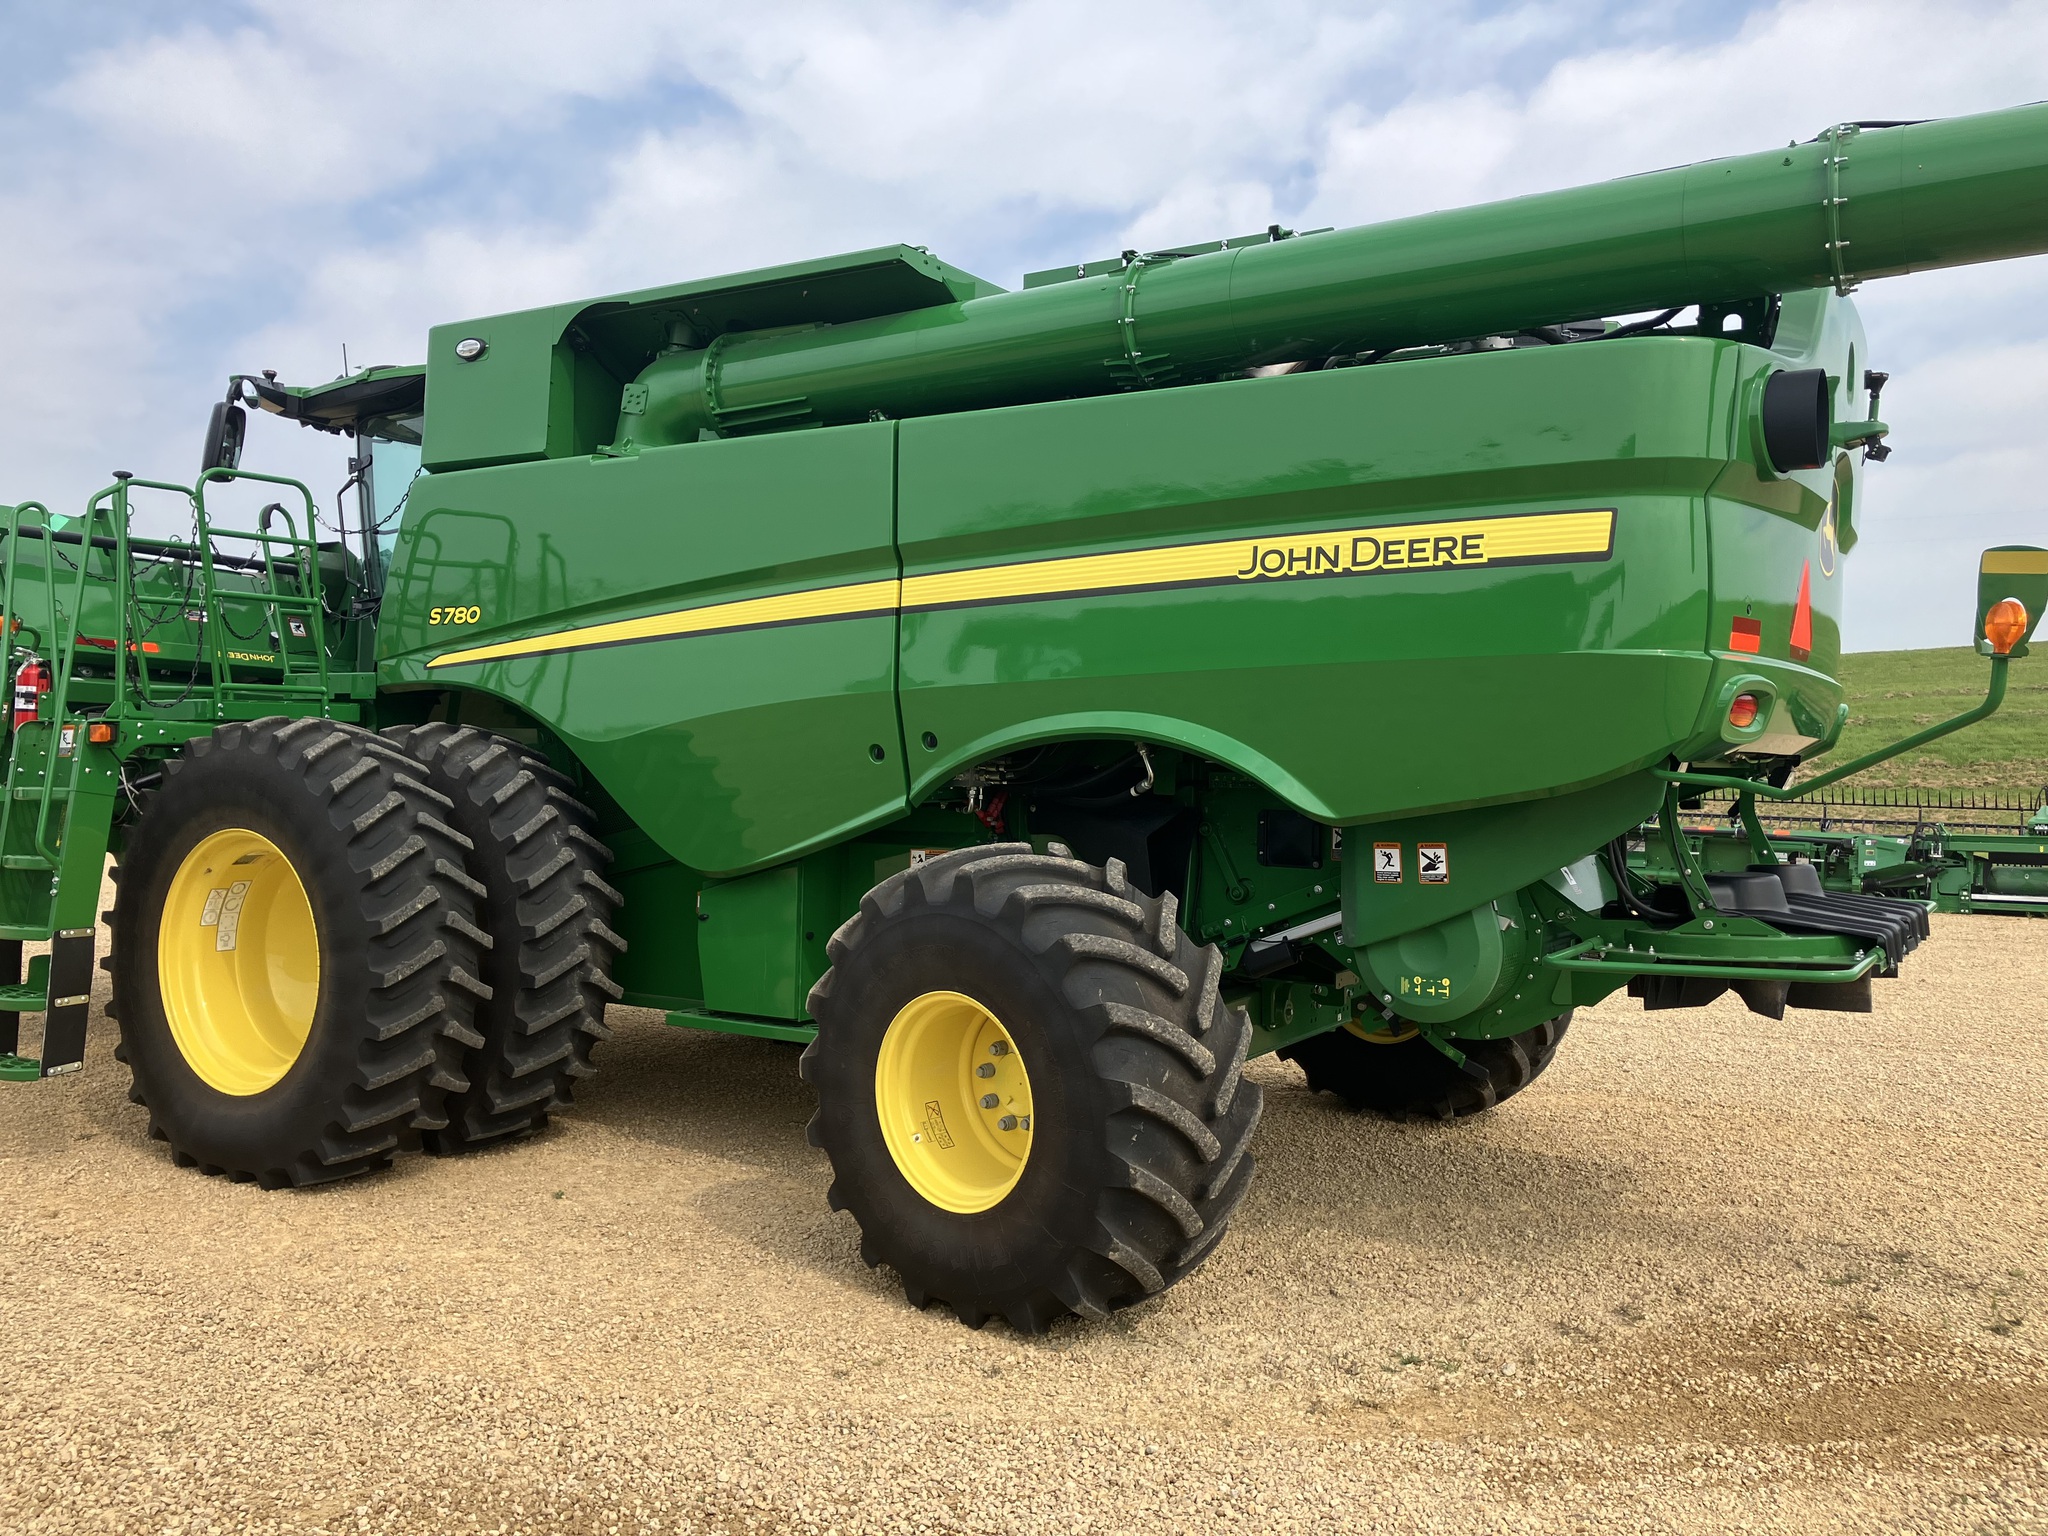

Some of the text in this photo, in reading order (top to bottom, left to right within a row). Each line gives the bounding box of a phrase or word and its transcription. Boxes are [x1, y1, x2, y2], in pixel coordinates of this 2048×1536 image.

[1238, 533, 1488, 579] JOHN DEERE
[429, 605, 481, 625] S780
